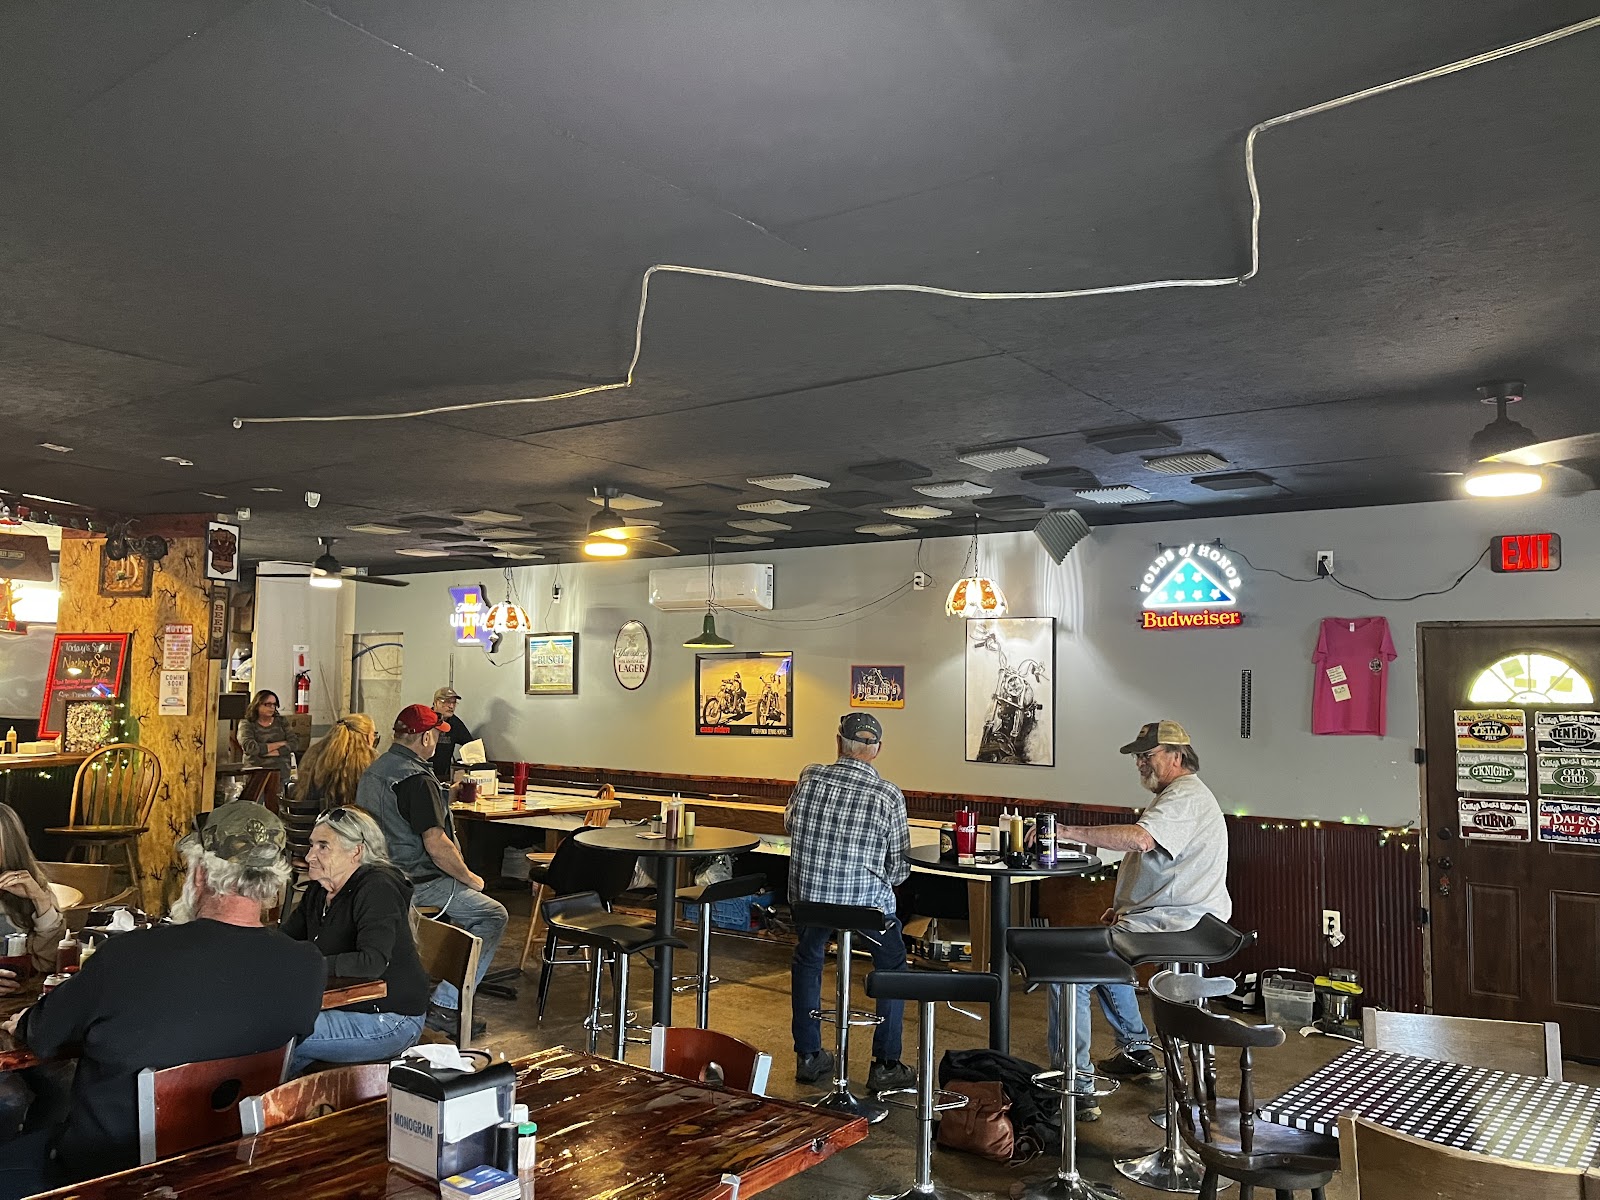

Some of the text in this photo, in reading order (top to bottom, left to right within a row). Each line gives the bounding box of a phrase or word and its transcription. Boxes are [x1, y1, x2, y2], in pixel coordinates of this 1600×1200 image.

[1502, 534, 1552, 570] EXIT
[1140, 543, 1241, 592] FOLDS of HONOR
[213, 604, 224, 633] BEER
[1143, 609, 1239, 628] Budweiser
[165, 625, 193, 633] NOTICE
[65, 642, 112, 654] Today's Spial
[537, 655, 564, 665] BUSCH
[618, 663, 645, 672] LAGER
[1472, 726, 1509, 736] YELLA
[1562, 768, 1585, 776] OLD
[1560, 775, 1589, 784] CHUB
[1552, 812, 1598, 827] DALE'S
[1552, 824, 1597, 835] PALE ALE
[394, 1112, 433, 1140] MONOGRAM
